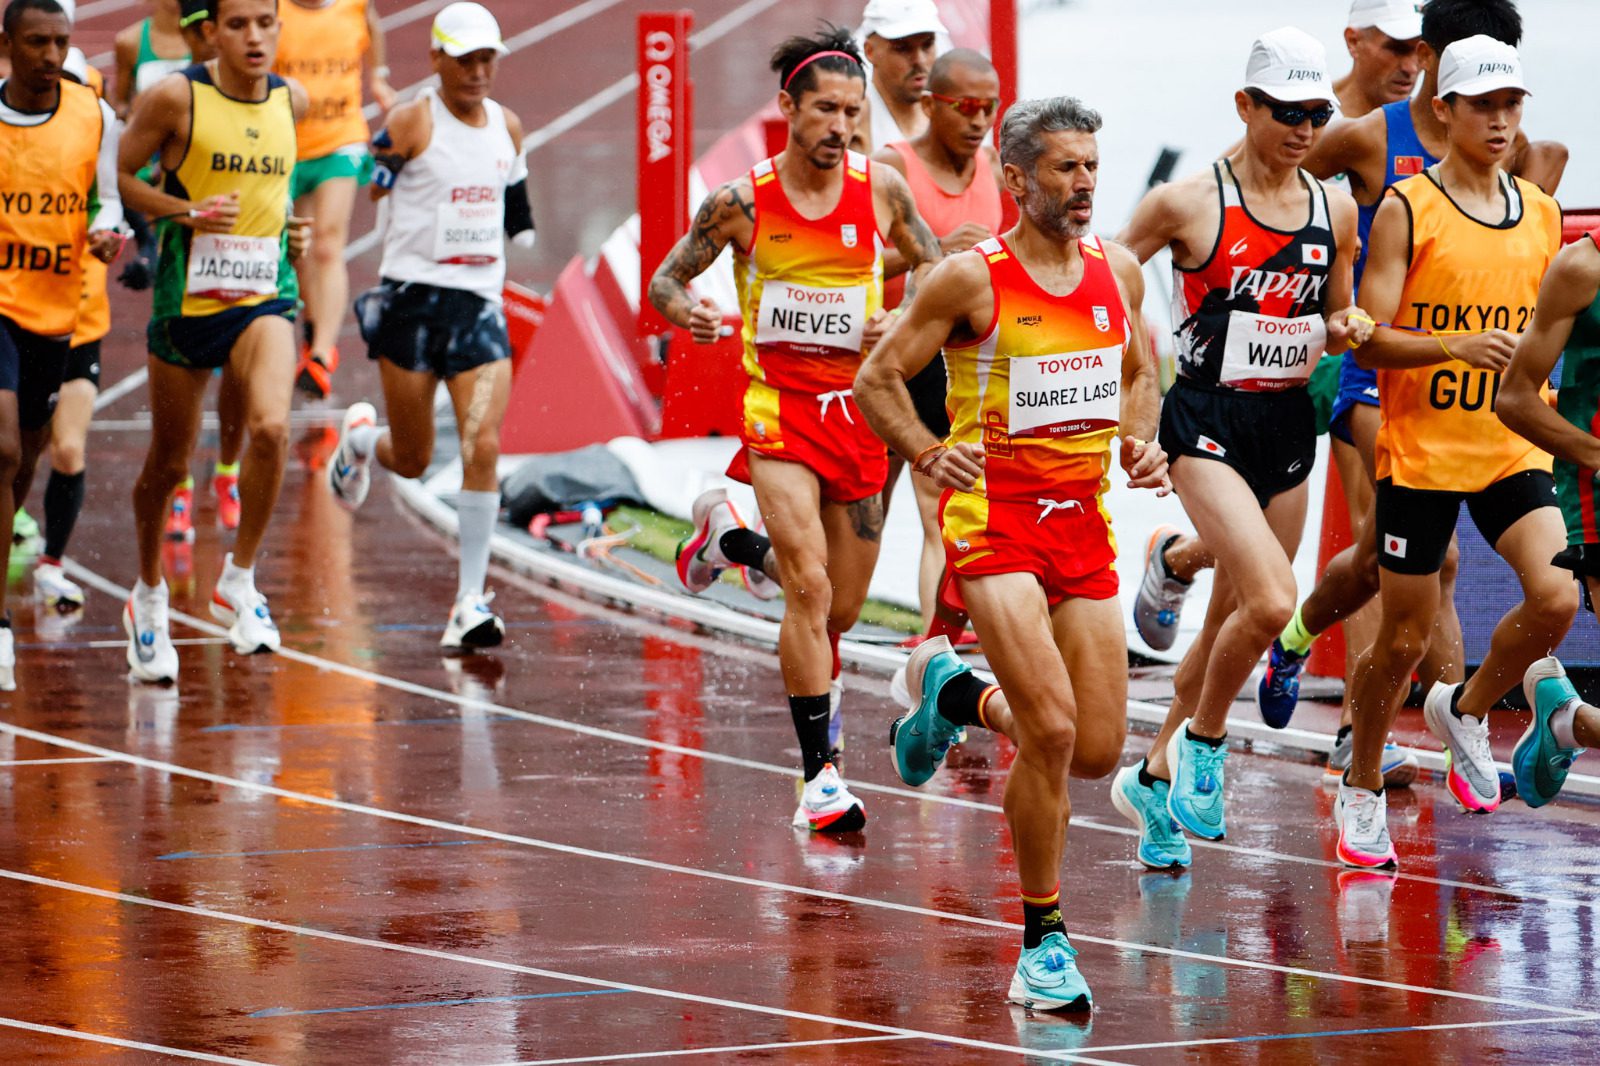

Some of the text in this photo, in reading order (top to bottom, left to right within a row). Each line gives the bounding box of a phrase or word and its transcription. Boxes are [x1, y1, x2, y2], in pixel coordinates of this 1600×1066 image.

[1286, 69, 1323, 82] JAPAN
[1478, 63, 1515, 76] JAPAN
[646, 64, 673, 163] OMEGA
[211, 153, 286, 176] BRASIL
[195, 256, 274, 280] JACQUES
[786, 287, 845, 304] TOYOTA
[1225, 266, 1328, 304] JAPAN
[771, 307, 852, 335] NIEVES
[1255, 319, 1312, 336] TOYOTA
[1411, 302, 1510, 333] TOKYO
[1037, 355, 1103, 374] TOYOTA
[1248, 342, 1308, 368] WADA
[1016, 380, 1117, 407] SUAREZ LASO
[1049, 425, 1068, 433] TOKYO
